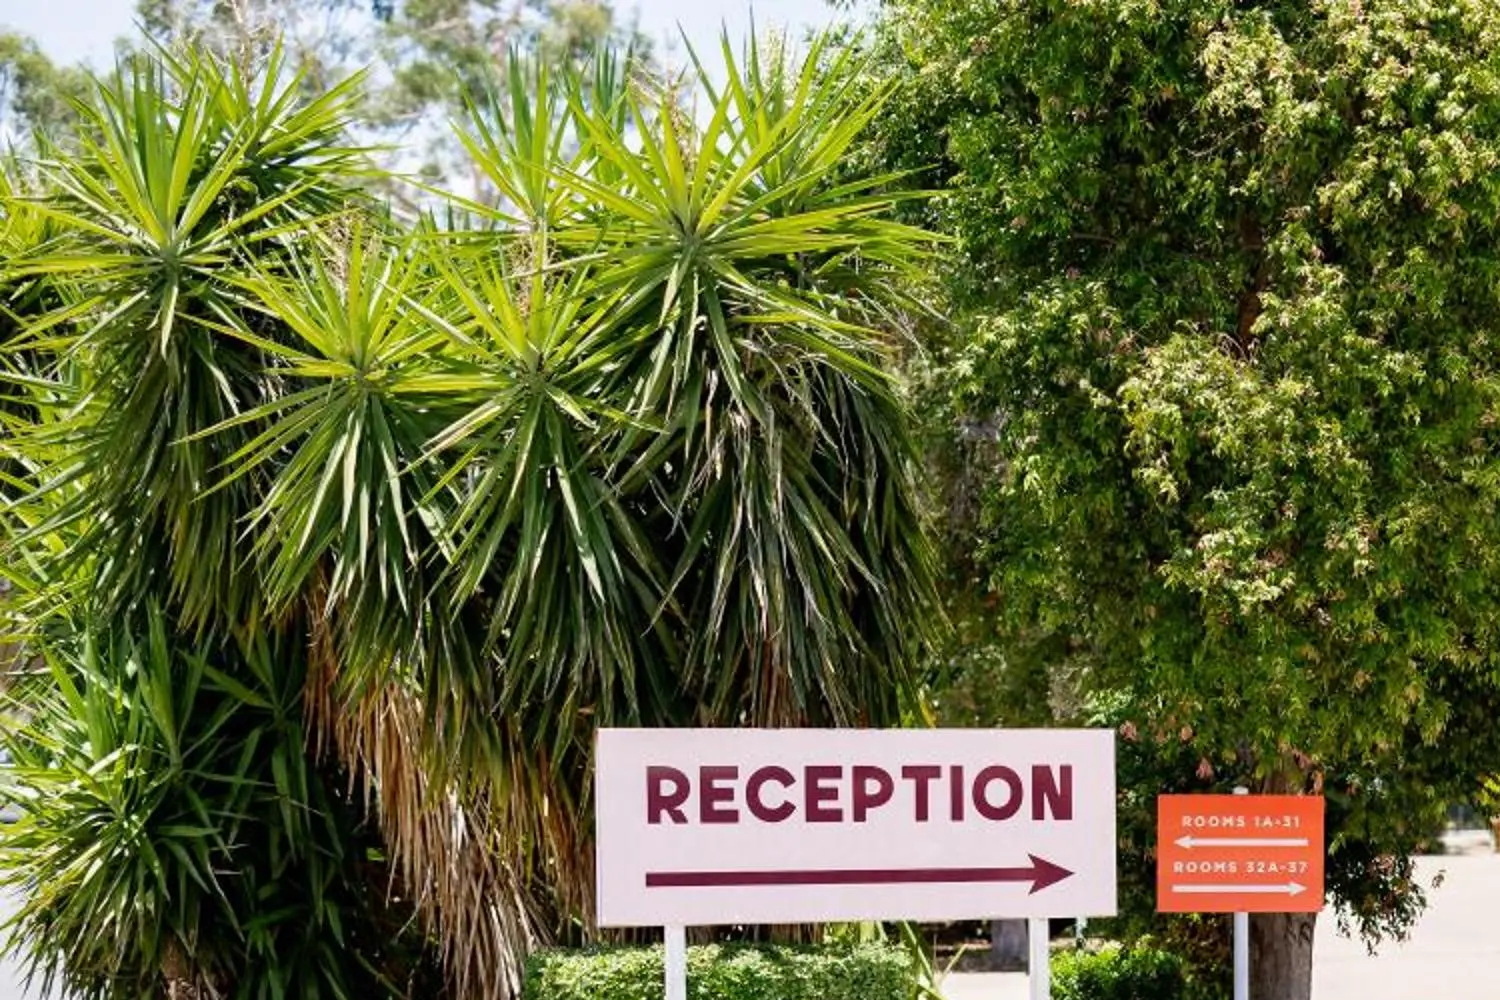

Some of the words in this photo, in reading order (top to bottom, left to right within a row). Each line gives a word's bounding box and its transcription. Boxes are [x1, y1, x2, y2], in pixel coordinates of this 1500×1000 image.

[647, 765, 1073, 823] RECEPTION
[1182, 815, 1245, 827] ROOMS
[1254, 815, 1300, 827] 1A-31
[1173, 861, 1238, 873] ROOMS
[1246, 861, 1308, 873] 32A-37
